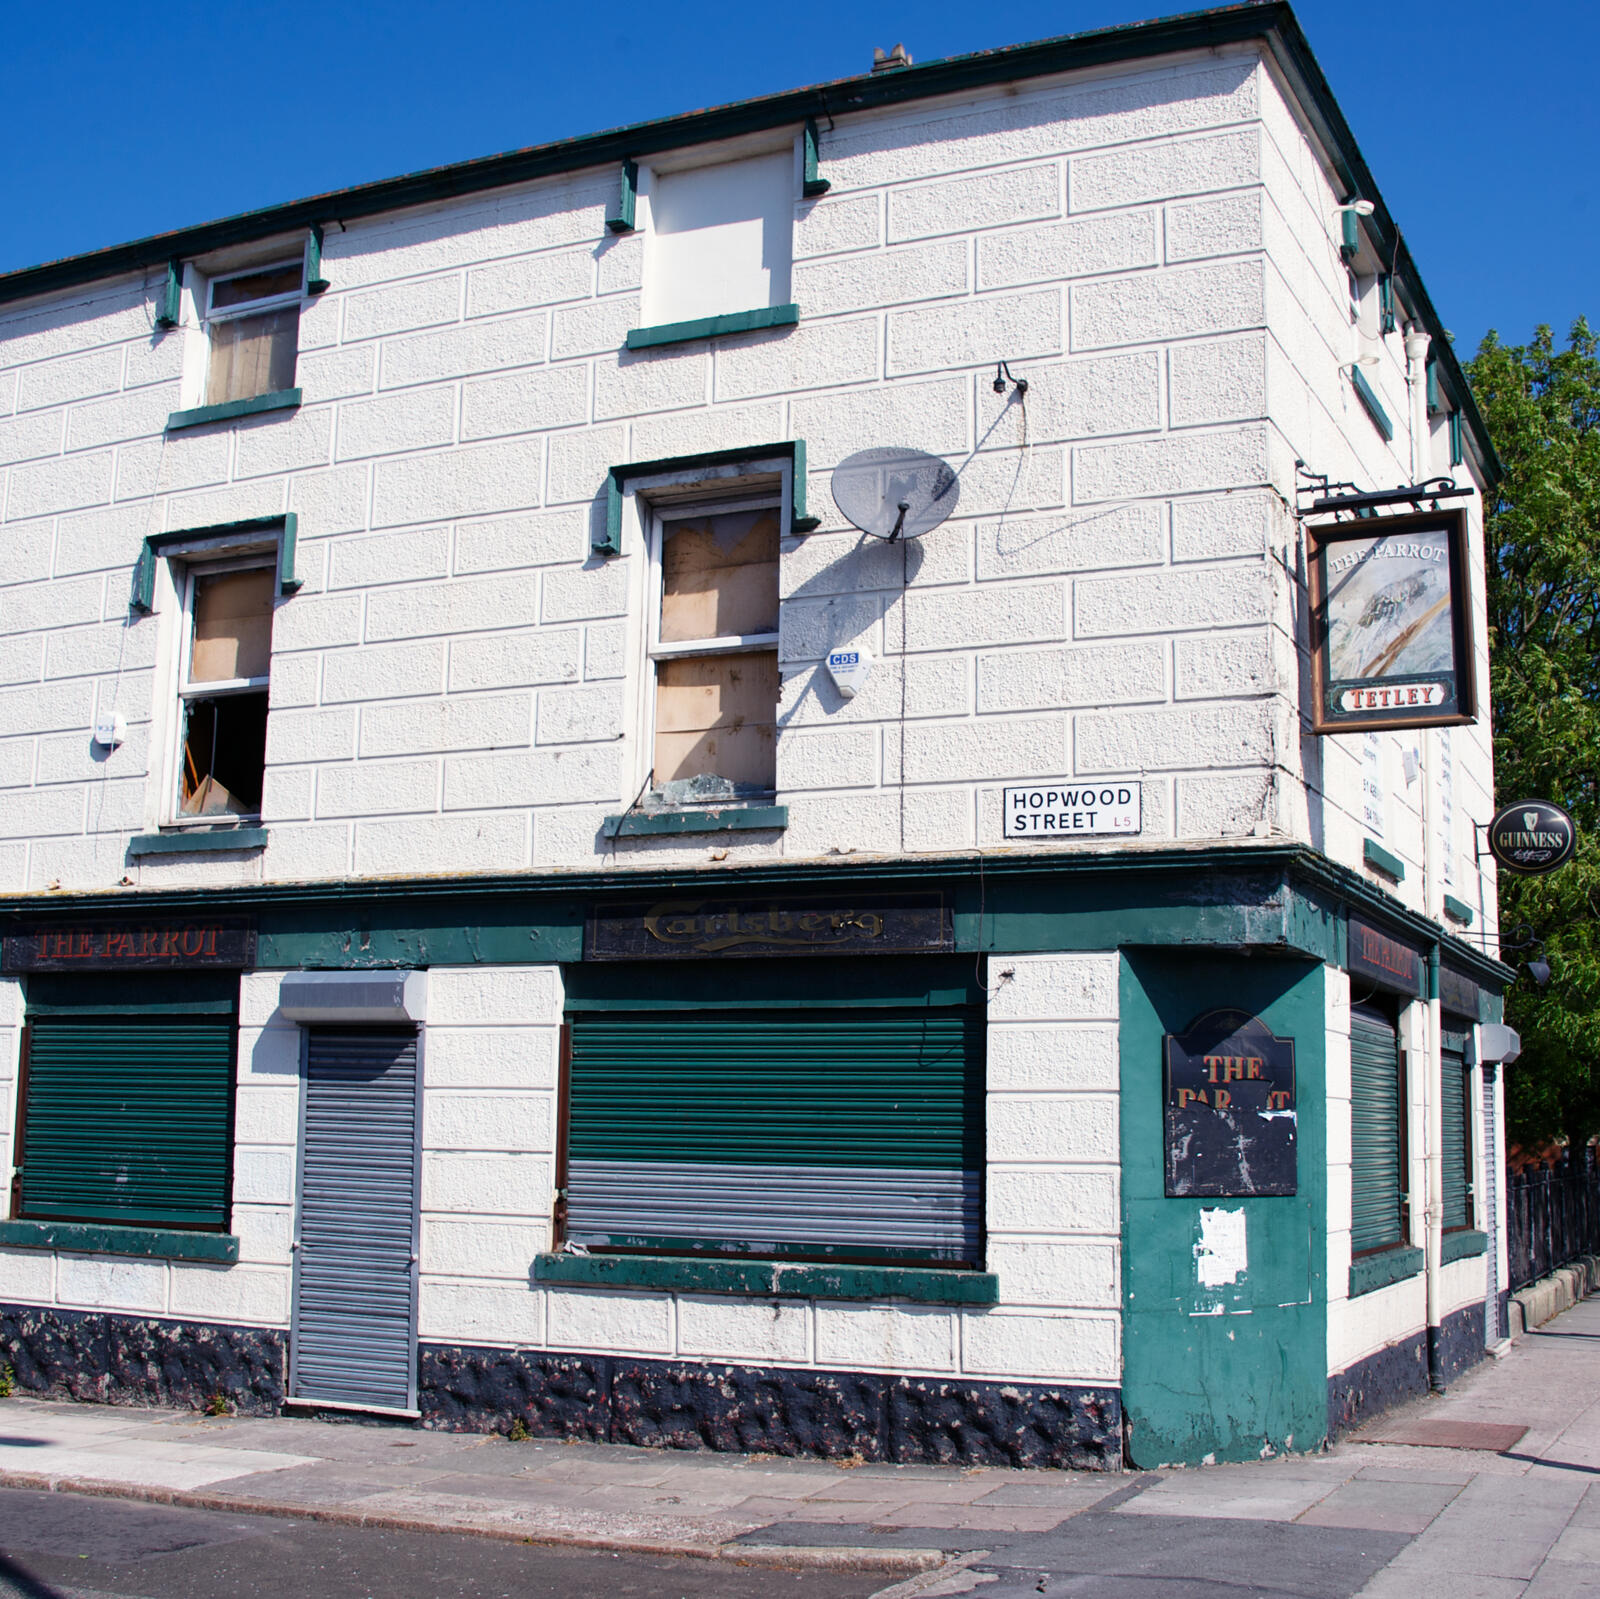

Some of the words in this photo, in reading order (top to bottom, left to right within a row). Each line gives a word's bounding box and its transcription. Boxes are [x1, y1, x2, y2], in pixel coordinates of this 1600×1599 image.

[1329, 548, 1369, 574] THE
[1372, 543, 1446, 562] PARROT
[832, 653, 857, 665] CDS
[1350, 686, 1434, 709] TETLEY
[1013, 788, 1131, 809] HOPWOOD
[1013, 811, 1098, 831] STREET
[1499, 831, 1563, 848] GUINNESS
[644, 900, 884, 945] Carlsberg
[34, 926, 94, 958] THE
[99, 923, 223, 957] PARROT
[1203, 1055, 1264, 1084] THE
